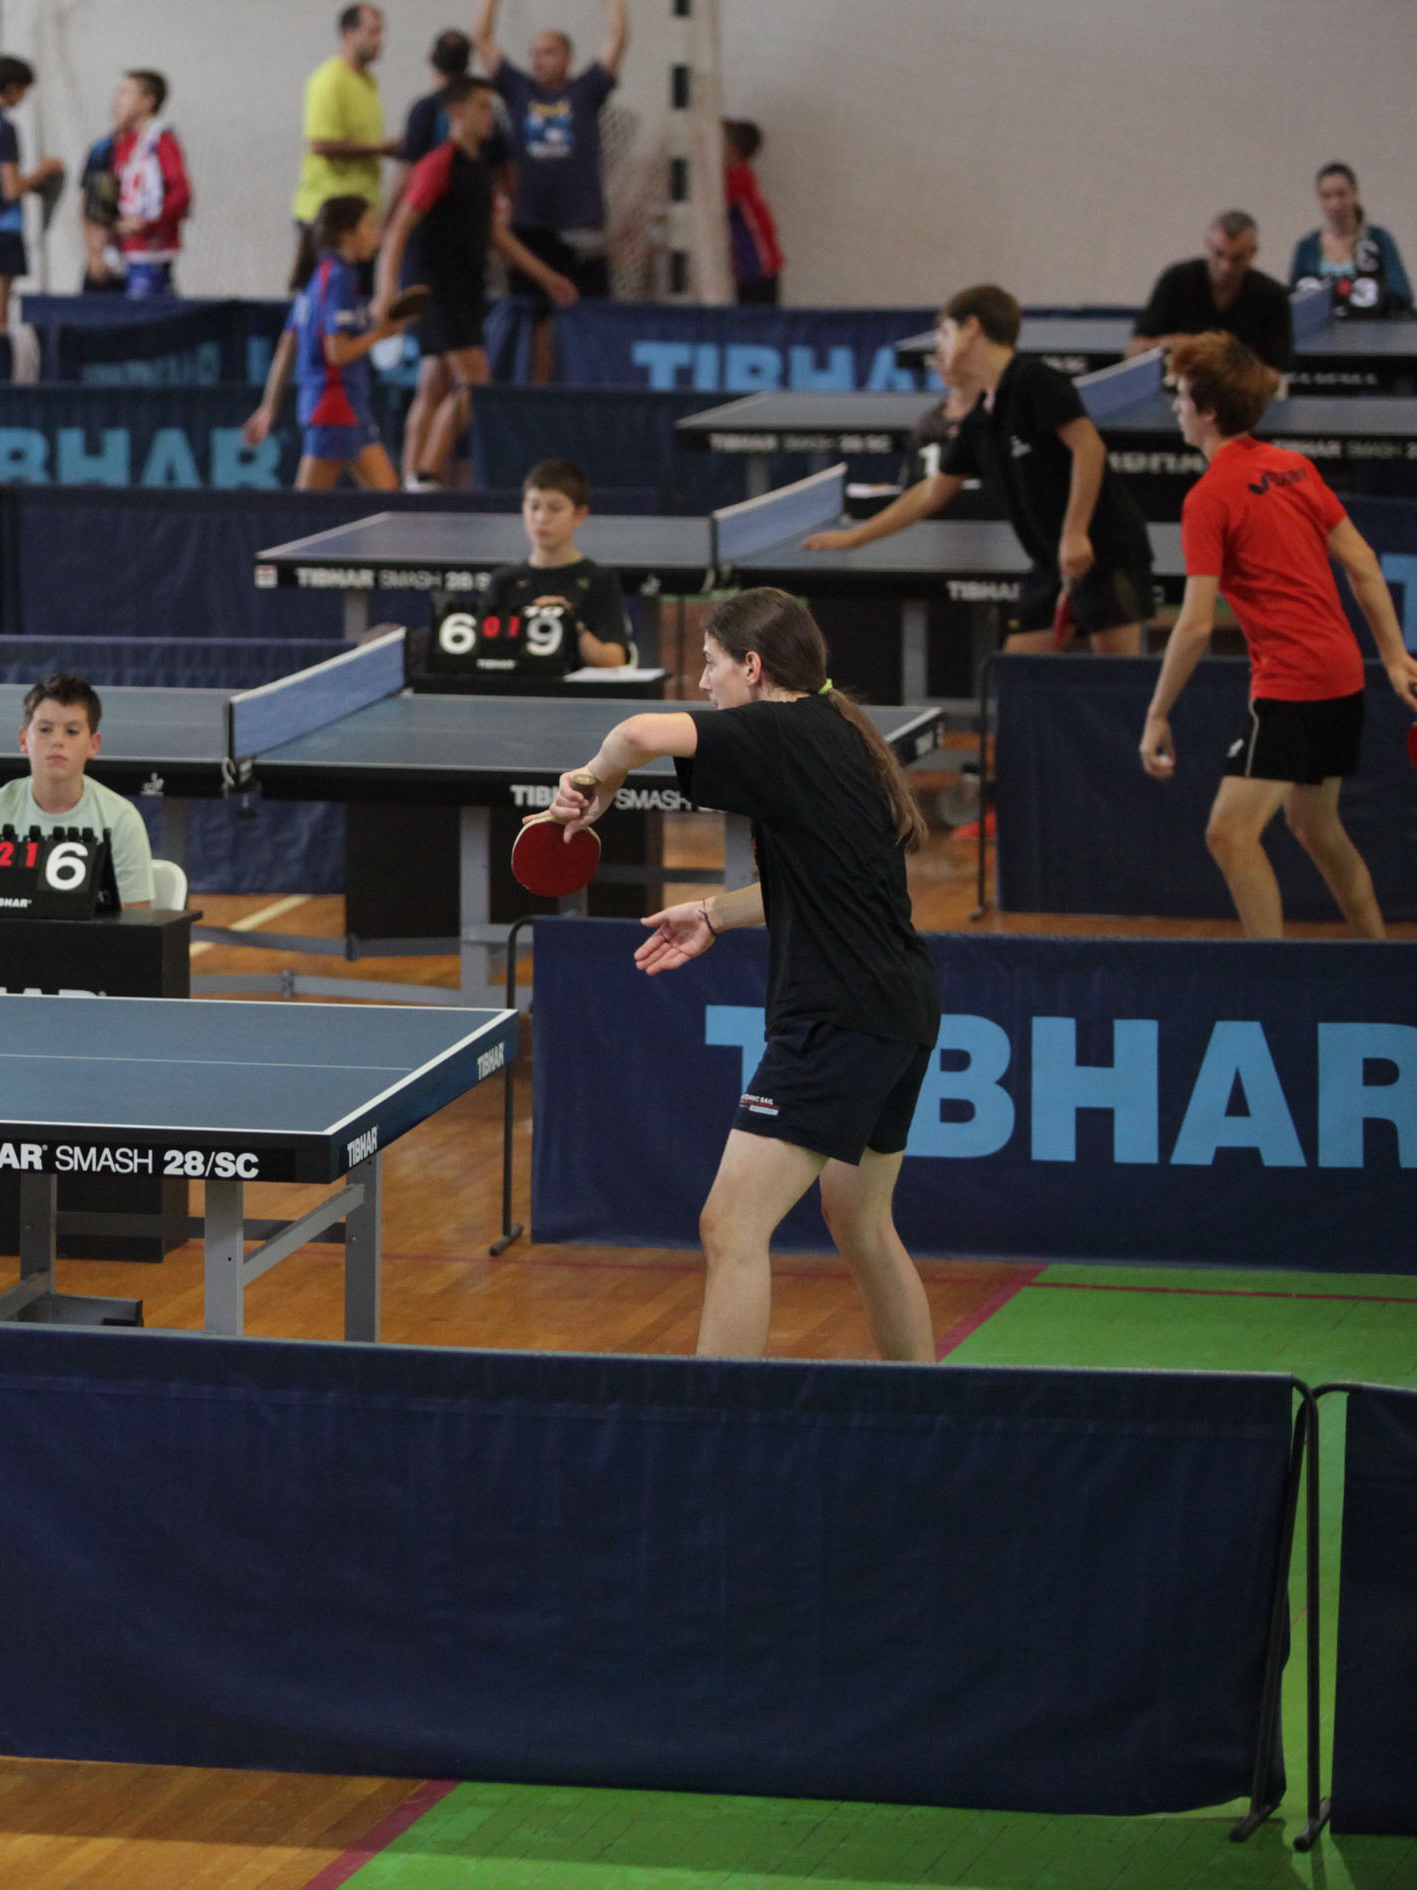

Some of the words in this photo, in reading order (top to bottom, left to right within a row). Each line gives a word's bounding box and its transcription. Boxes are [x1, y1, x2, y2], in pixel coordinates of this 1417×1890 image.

[633, 341, 945, 391] TIBHA
[946, 581, 1020, 601] TIBHA
[439, 613, 477, 655] 6
[526, 618, 563, 656] 9
[510, 784, 561, 806] TIB
[24, 842, 37, 867] 1
[45, 842, 89, 891] 6
[477, 1042, 504, 1081] TIBHAR
[705, 1004, 1417, 1168] BHAR
[55, 1145, 153, 1174] SMASH
[163, 1150, 259, 1178] 28/SC
[347, 1126, 378, 1168] TIBHAR
